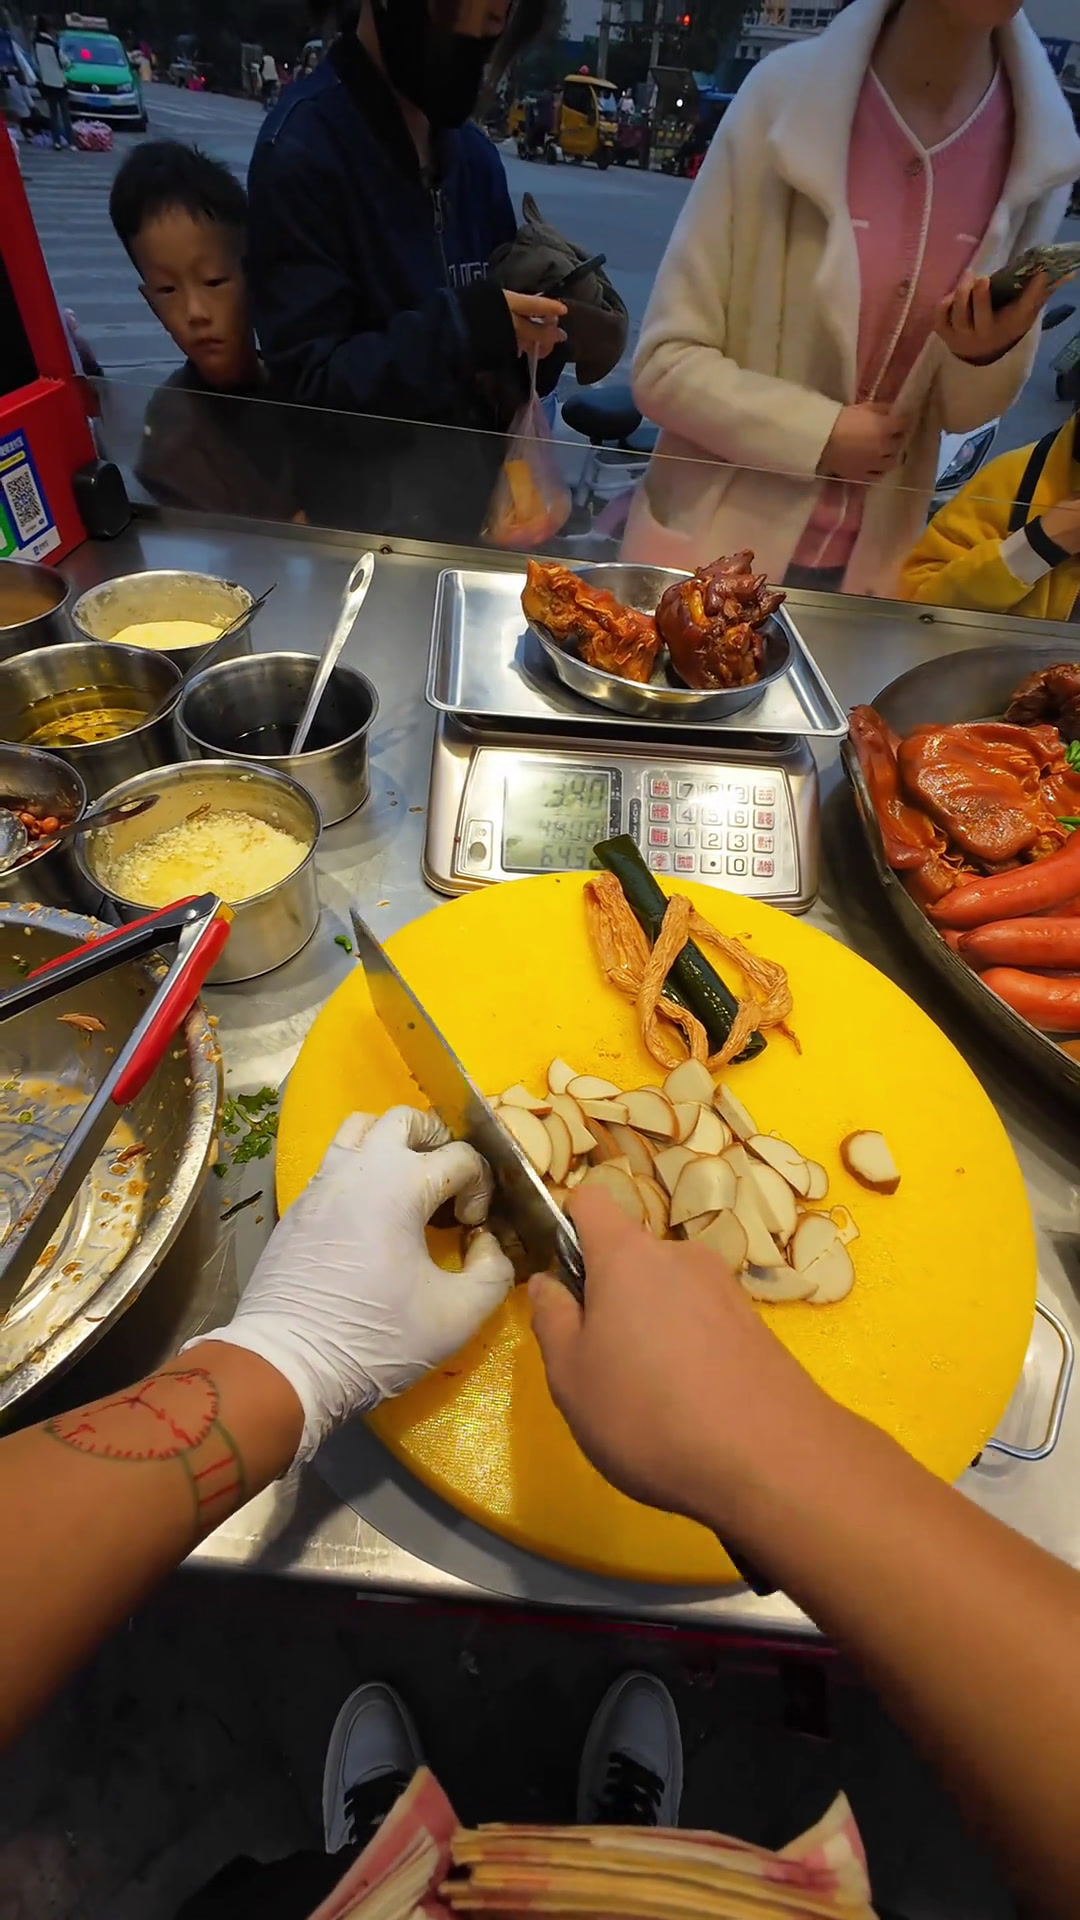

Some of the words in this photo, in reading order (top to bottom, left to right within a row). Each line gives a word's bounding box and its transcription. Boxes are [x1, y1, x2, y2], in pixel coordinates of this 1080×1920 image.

[682, 783, 694, 798] 7
[681, 809, 693, 822] 4
[708, 809, 719, 823] 5
[734, 810, 745, 824] 6
[683, 831, 691, 846] 1
[708, 832, 719, 847] 2
[734, 834, 745, 848] 3
[733, 858, 745, 873] 0
